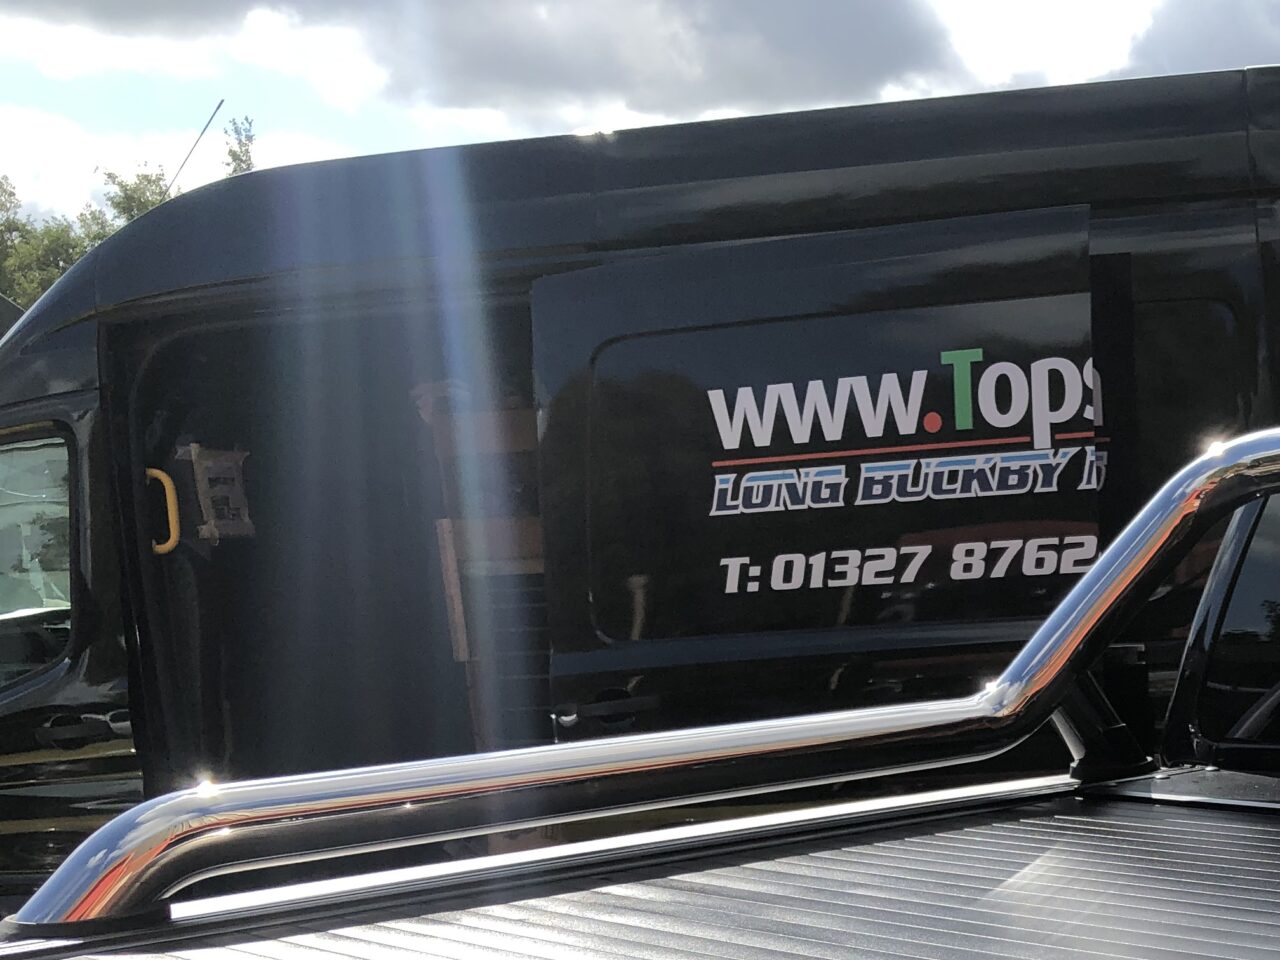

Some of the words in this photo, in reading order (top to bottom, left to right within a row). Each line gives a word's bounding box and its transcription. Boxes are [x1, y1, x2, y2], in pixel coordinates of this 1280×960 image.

[709, 465, 849, 516] LONG
[854, 447, 1082, 506] BUCKBY
[950, 535, 1098, 581] 8762
